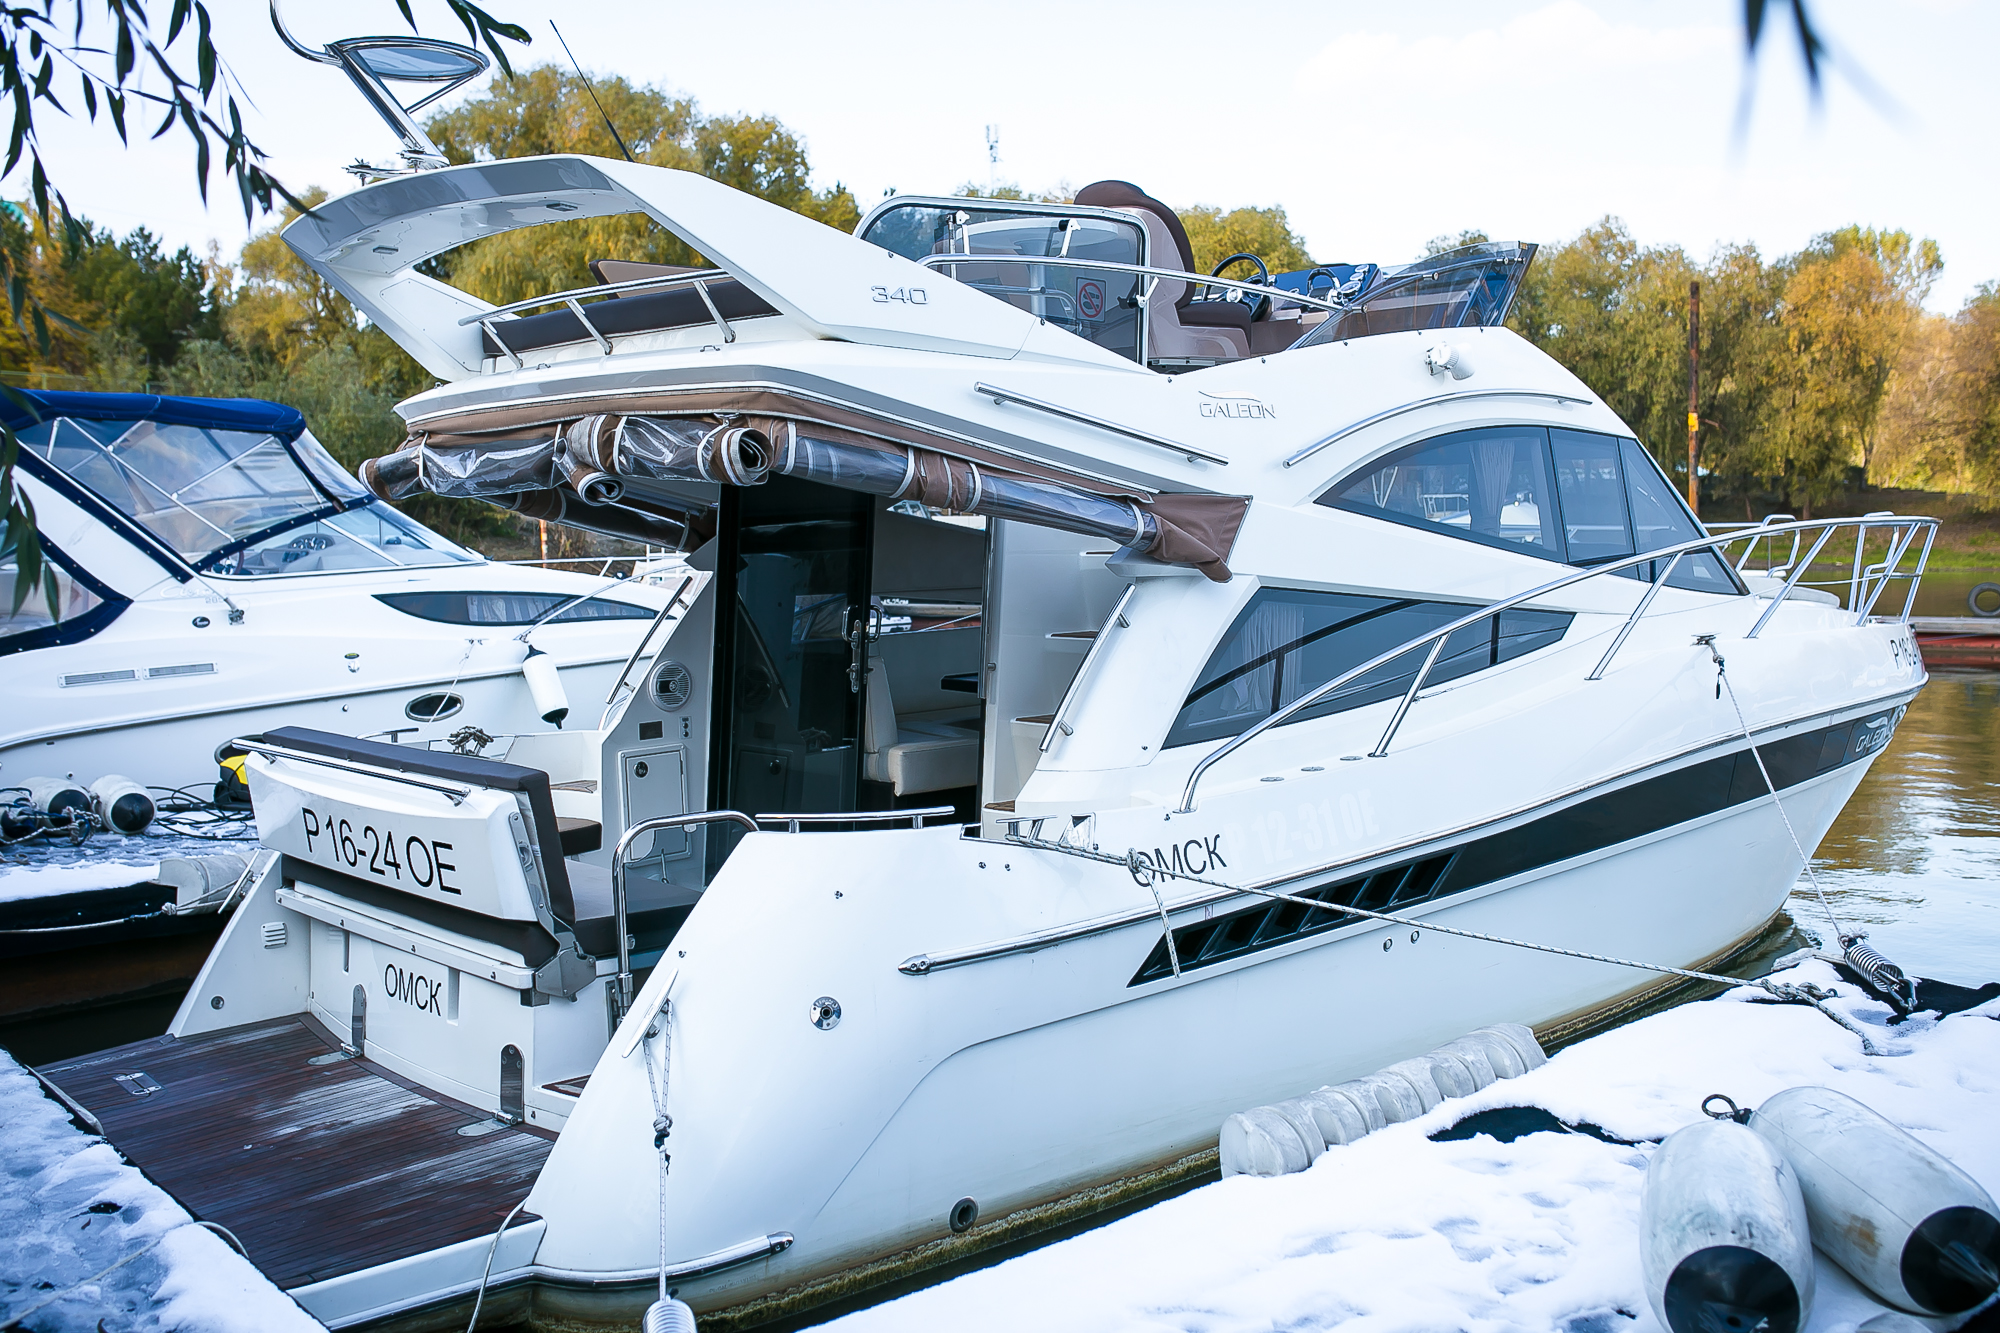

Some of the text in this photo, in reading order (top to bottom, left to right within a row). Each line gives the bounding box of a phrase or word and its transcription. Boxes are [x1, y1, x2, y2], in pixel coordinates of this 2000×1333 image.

[871, 286, 928, 305] 340
[1199, 402, 1277, 420] GALEON
[325, 814, 402, 880] 16-24
[1127, 833, 1228, 888] ОМСК
[384, 963, 442, 1017] ОМСК
